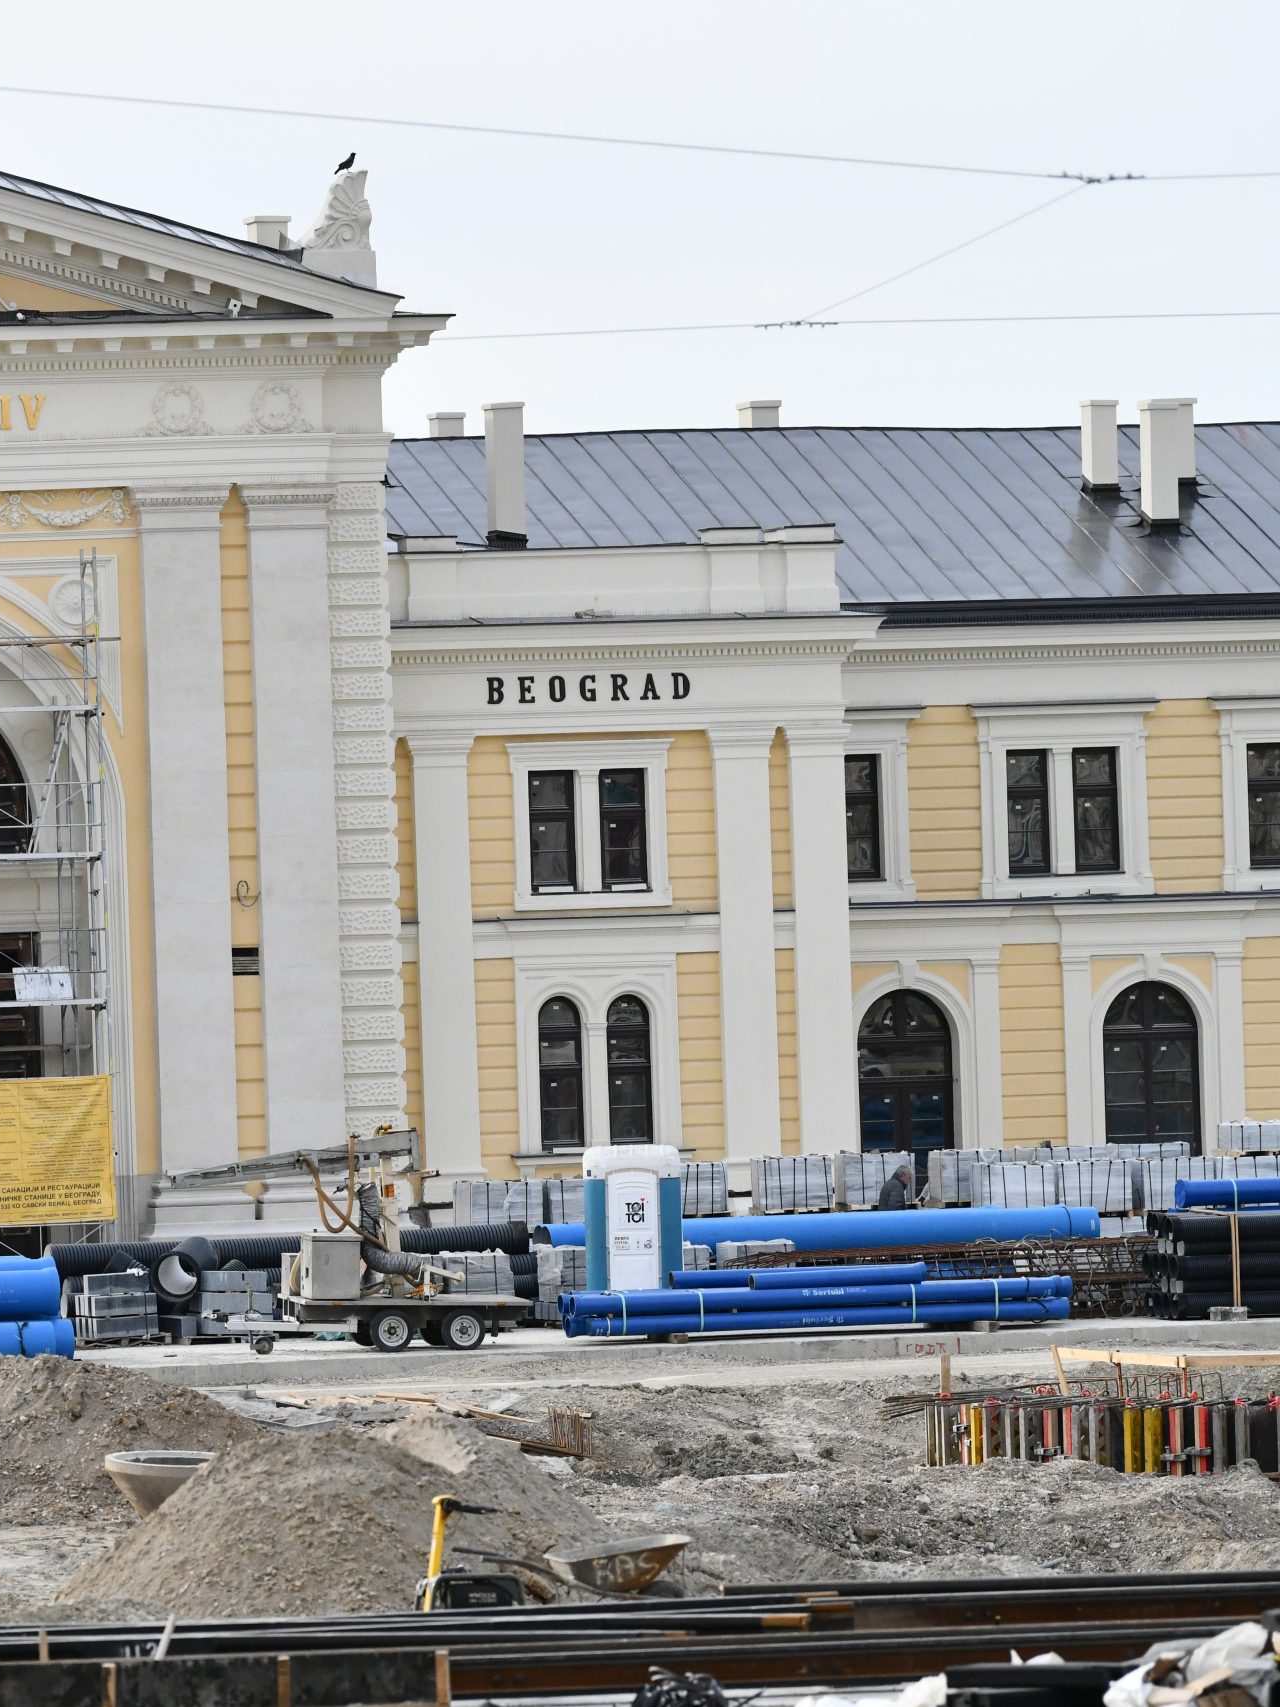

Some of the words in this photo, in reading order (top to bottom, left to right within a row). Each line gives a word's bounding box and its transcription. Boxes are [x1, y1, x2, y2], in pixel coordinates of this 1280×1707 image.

[487, 672, 691, 704] BEOGRAD
[2, 1186, 39, 1194] САНАЦИЈИ
[47, 1182, 101, 1191] РЕСТАУРАЦИЈИ
[24, 1193, 56, 1201] СТАНИЦЕ
[21, 1201, 47, 1209] САВСКИ
[625, 1198, 645, 1213] TOI
[625, 1213, 645, 1223] TOI
